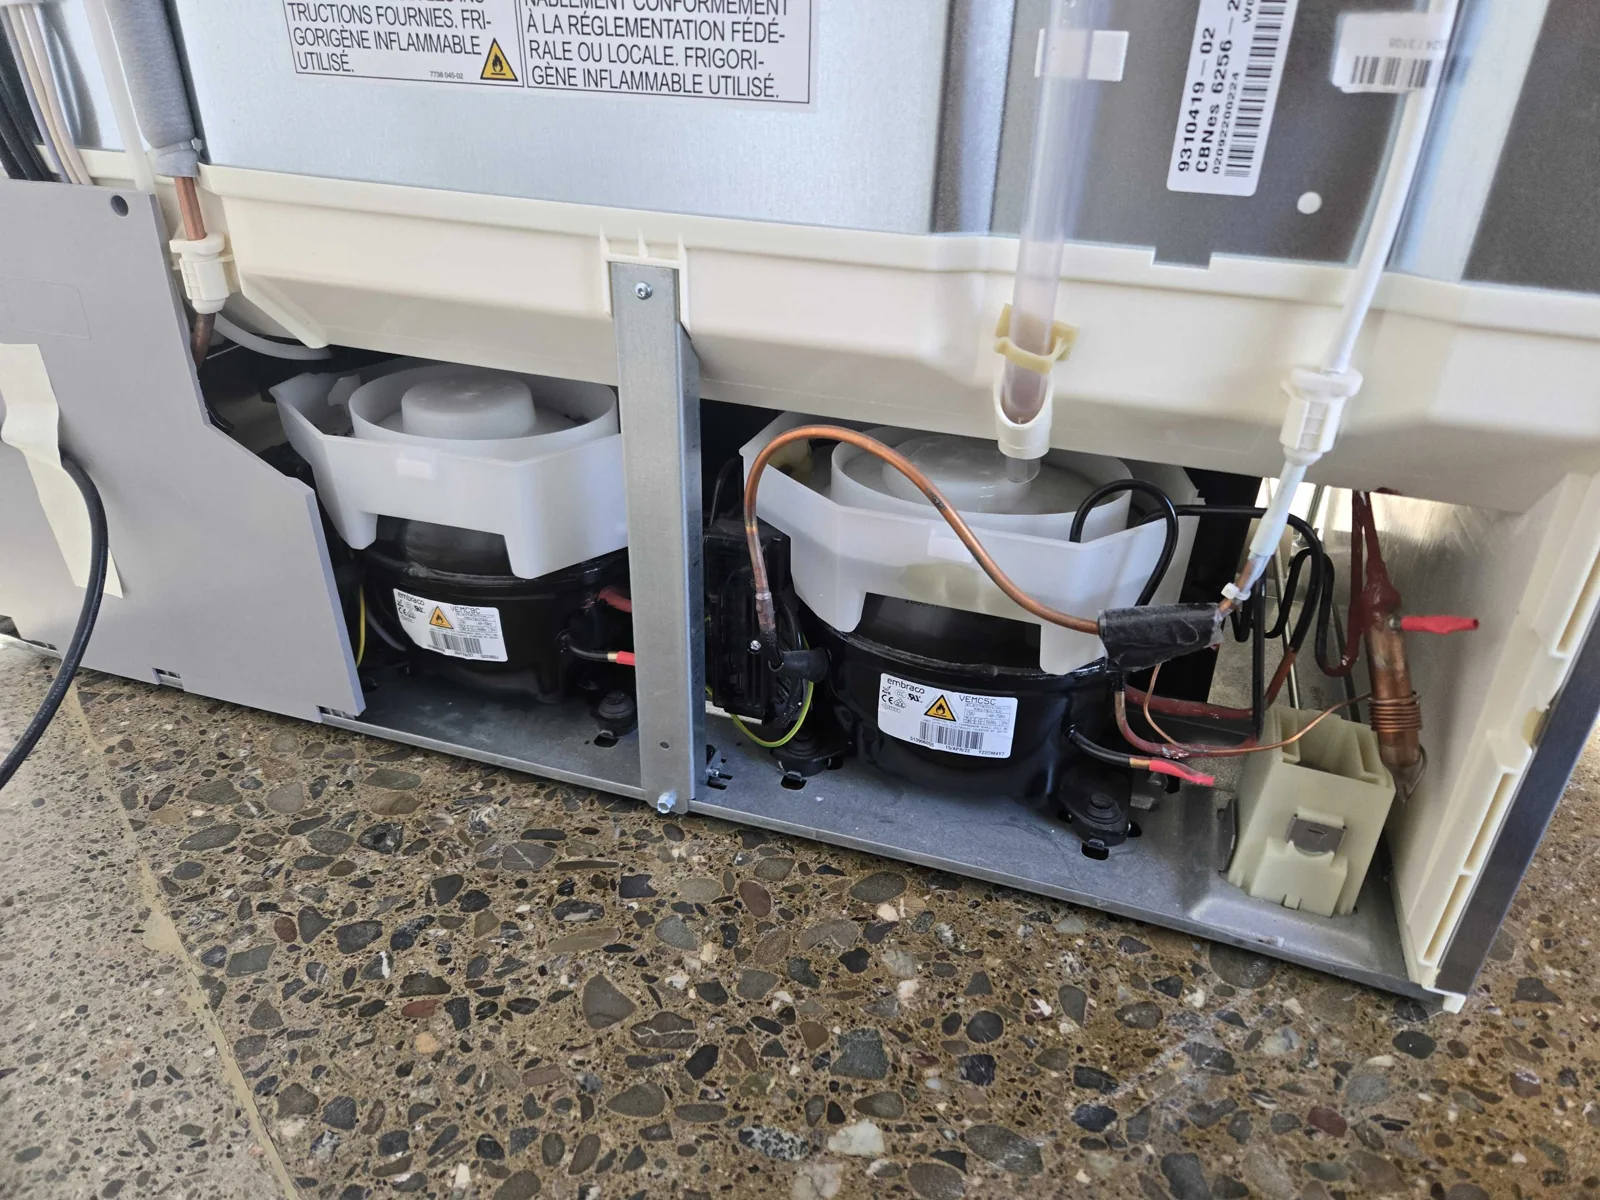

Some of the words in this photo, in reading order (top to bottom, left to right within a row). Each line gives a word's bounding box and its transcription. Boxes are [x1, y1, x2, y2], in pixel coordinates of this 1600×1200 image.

[287, 2, 373, 25] TRUCTIONS
[376, 5, 458, 29] FOURNIES.
[461, 9, 492, 30] FRI-
[527, 8, 539, 34] À
[542, 13, 564, 35] LA
[568, 10, 725, 41] RÉGLEMENTATION
[731, 17, 785, 44] FÉDÉ-
[293, 24, 370, 49] GORIGÈNE
[374, 30, 482, 56] INFLAMMABLE
[529, 40, 573, 61] RALE
[578, 41, 602, 62] OU
[607, 43, 678, 66] LOCALE.
[685, 46, 764, 70] FRIGORI-
[297, 49, 354, 73] UTILISÉ.
[531, 62, 578, 87] GÈNE
[583, 68, 703, 94] INFLAMMABLE
[708, 72, 779, 98] UTILISÉ.
[1212, 71, 1240, 174] 02092200224
[1195, 104, 1221, 173] CBNes
[397, 591, 425, 606] embraco
[887, 678, 925, 695] embraco
